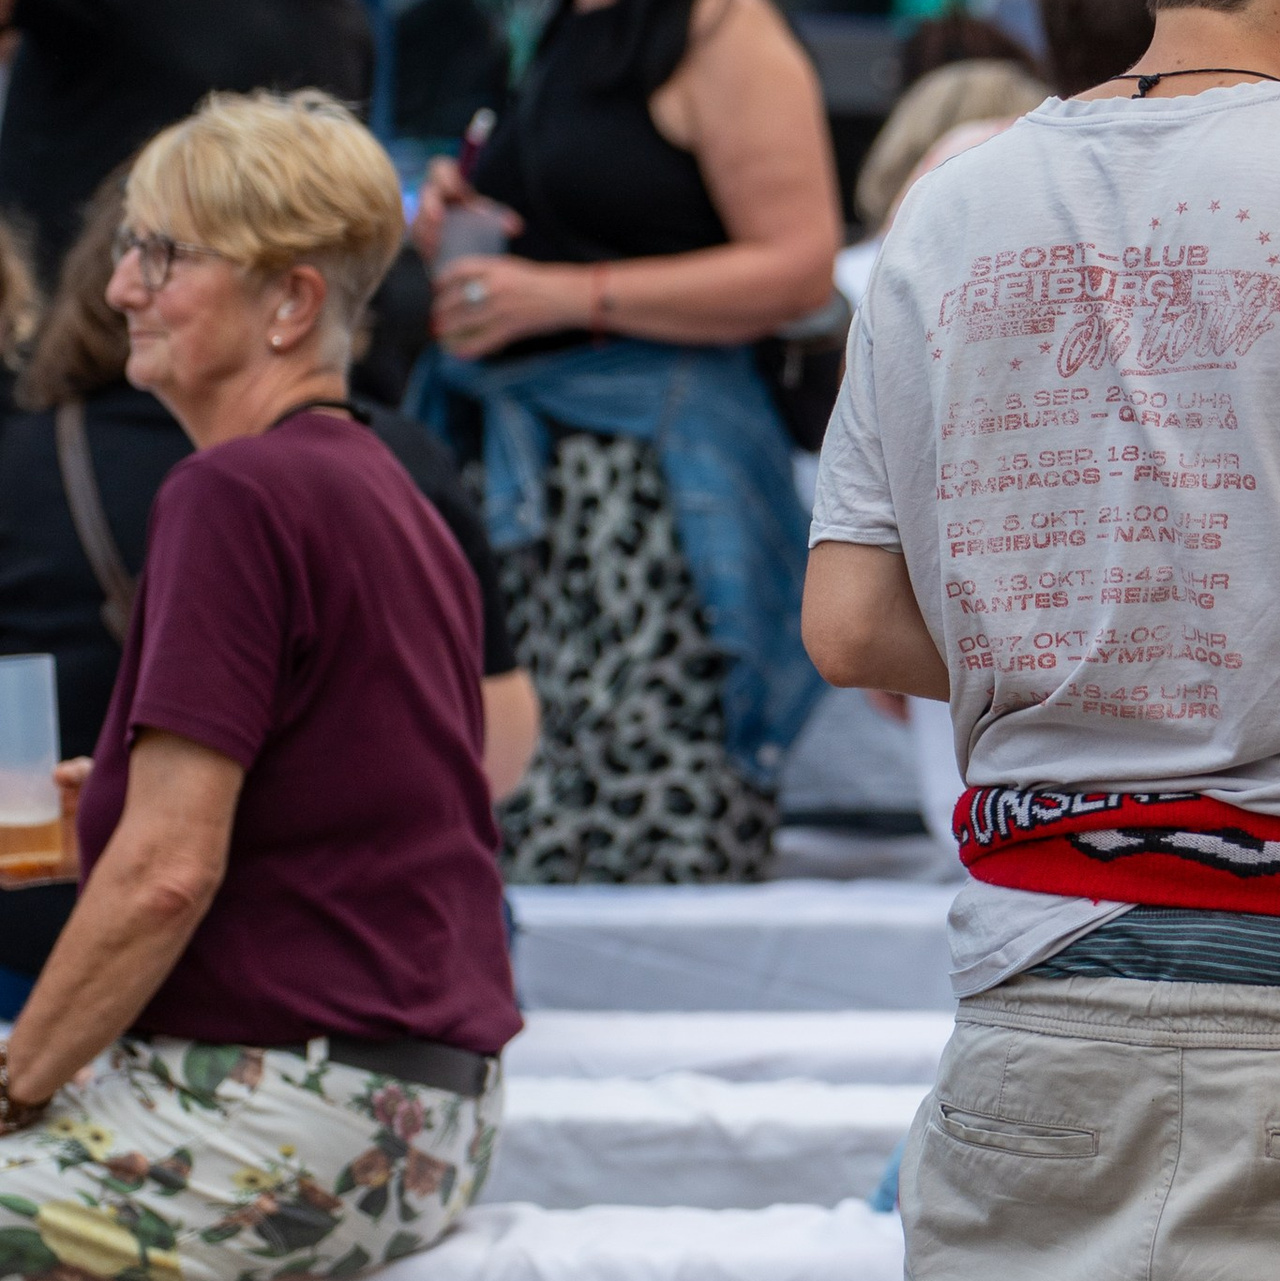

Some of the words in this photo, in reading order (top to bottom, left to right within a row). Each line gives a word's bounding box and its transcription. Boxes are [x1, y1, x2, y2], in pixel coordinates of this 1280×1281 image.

[1032, 387, 1092, 407] SEP.
[1176, 392, 1232, 409] UHR
[940, 408, 1080, 440] FREIBURG
[1038, 447, 1097, 468] SEP.
[1178, 452, 1240, 469] UHR
[936, 467, 1101, 500] LYMPIACOS
[1030, 509, 1087, 529] OKT.
[1098, 505, 1169, 524] 21:00
[950, 529, 1086, 558] FREIBURG
[1038, 569, 1094, 589] OKT.
[960, 590, 1069, 614] NANTES
[1182, 624, 1228, 649] UHR
[1160, 683, 1219, 701] UHR
[1082, 700, 1223, 720] FREIBURG
